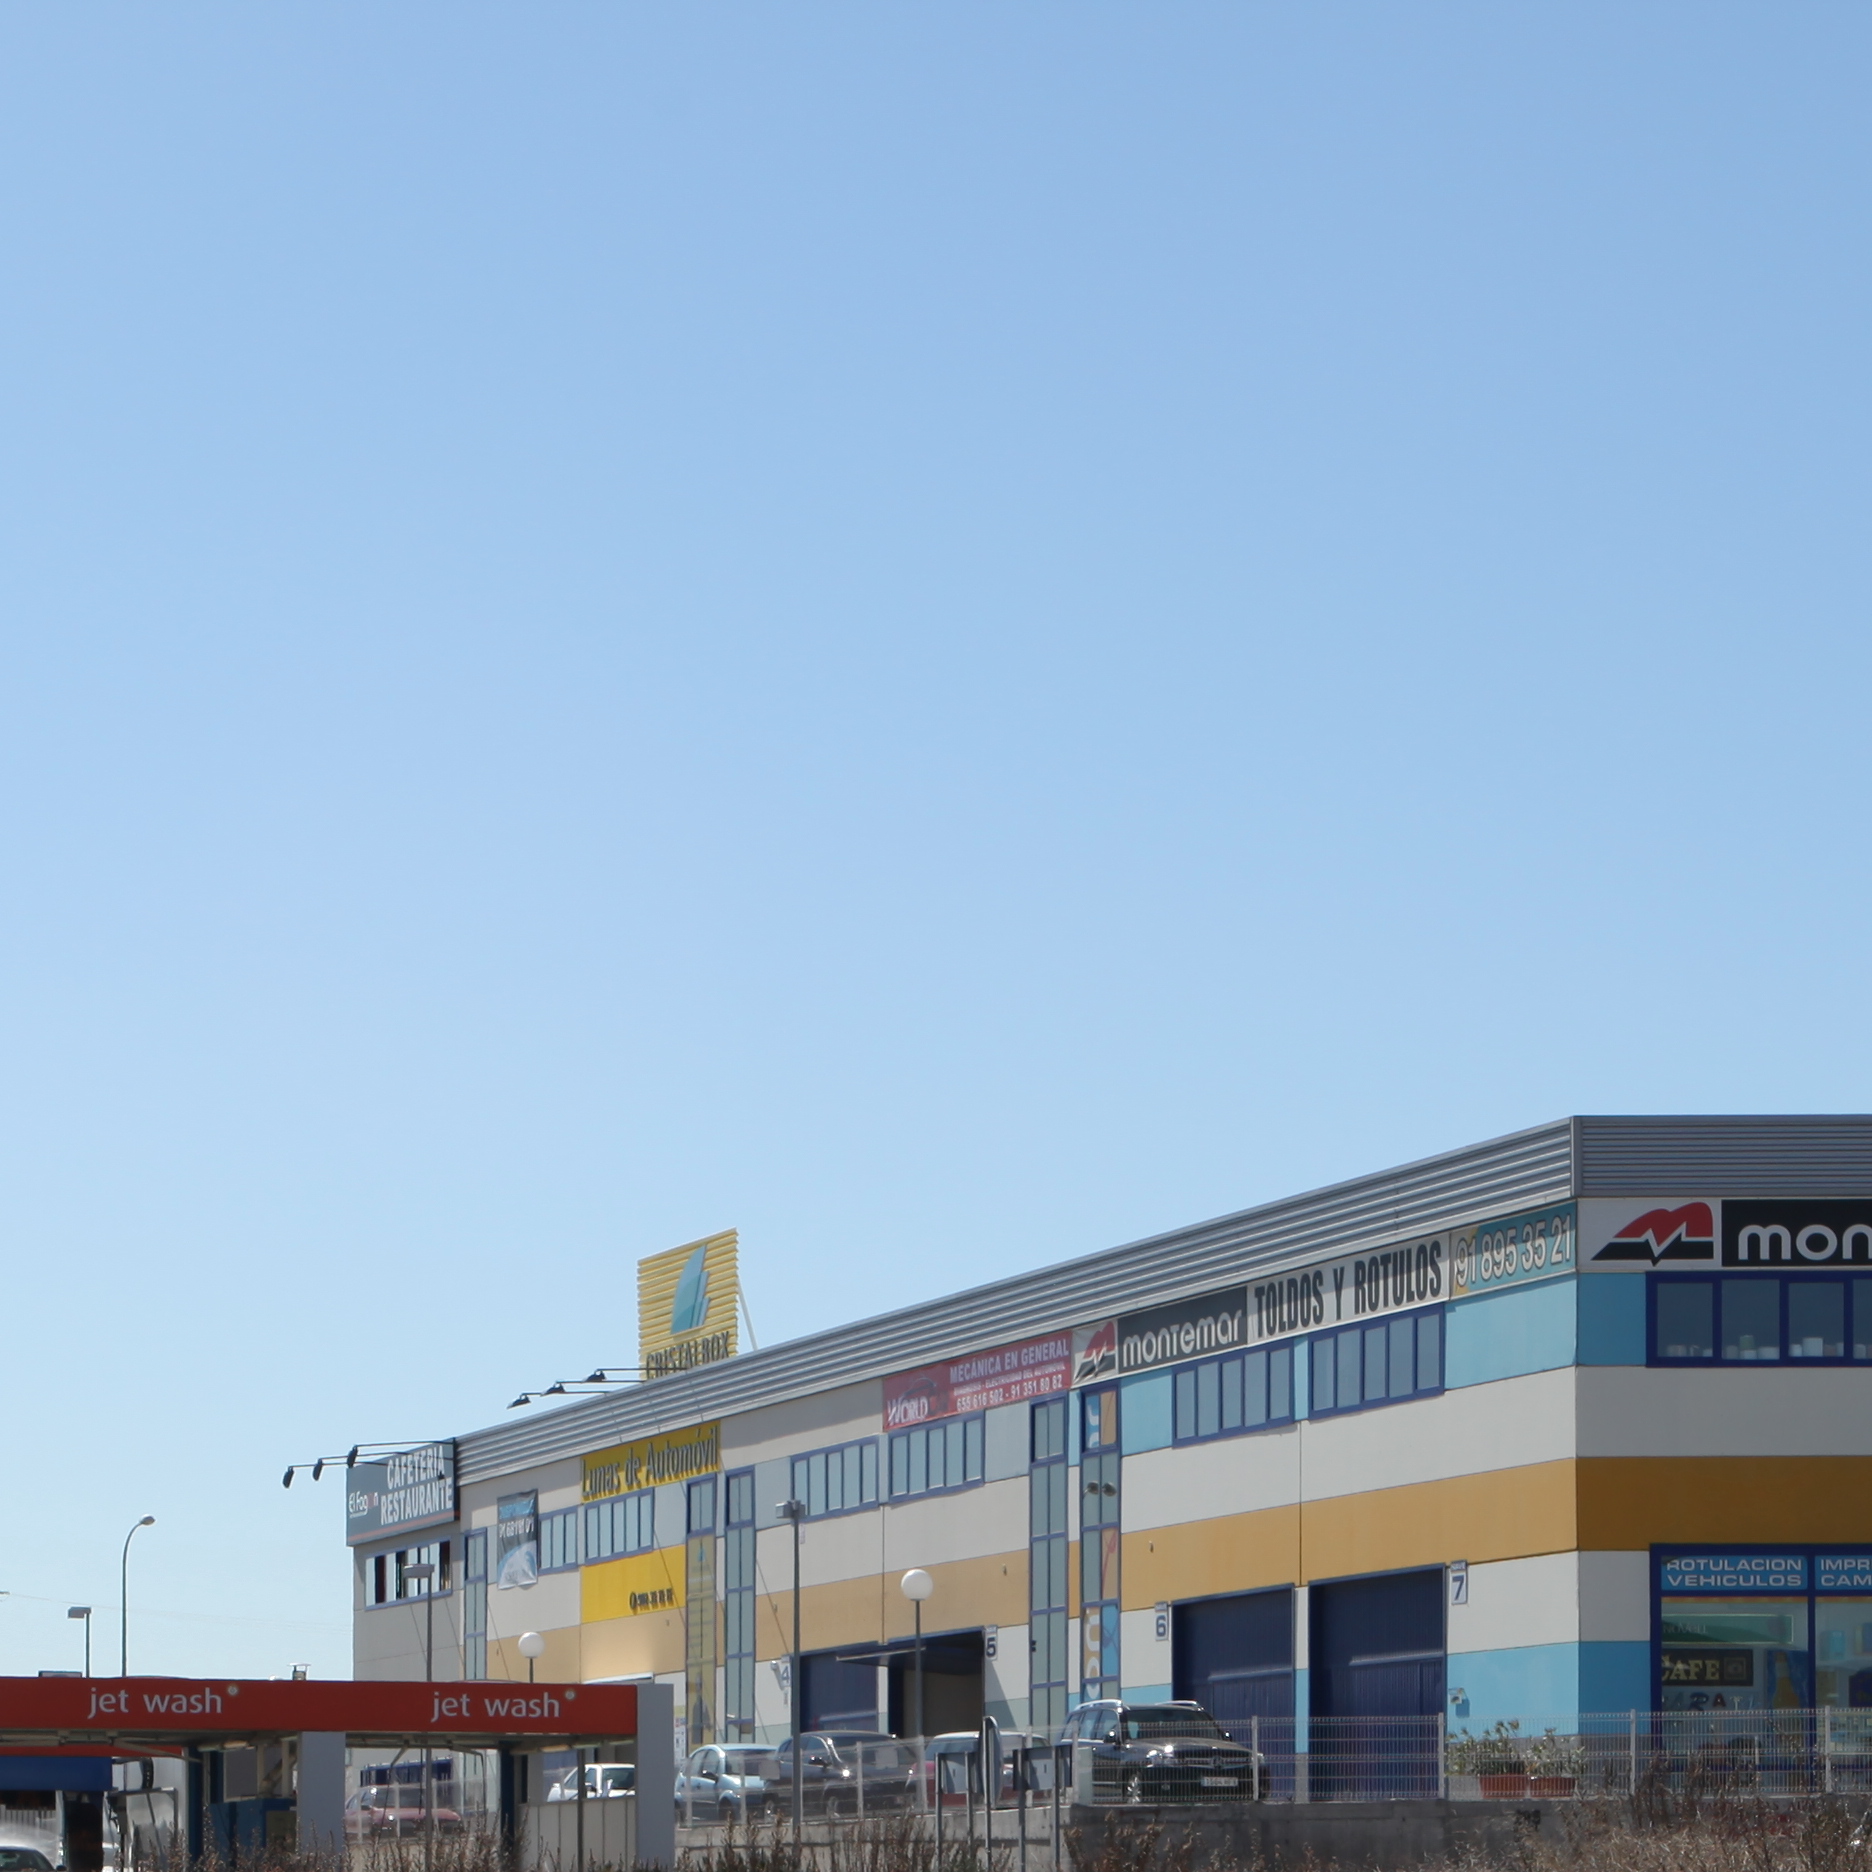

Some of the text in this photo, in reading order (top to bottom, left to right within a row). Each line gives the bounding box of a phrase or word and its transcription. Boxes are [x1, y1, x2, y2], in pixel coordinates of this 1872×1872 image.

[1254, 1270, 1324, 1339] TOLDOS
[1333, 1267, 1346, 1321] Y
[1354, 1240, 1442, 1315] ROTULOS
[1455, 1236, 1477, 1287] 91
[1481, 1227, 1518, 1281] 895
[1521, 1219, 1547, 1272] 35
[1550, 1213, 1572, 1266] 21
[1005, 1351, 1018, 1368] EN
[1021, 1339, 1069, 1366] GENERAL
[582, 1426, 719, 1497] Lunas de Automóvil
[380, 1477, 453, 1525] RESTAURANTE
[1666, 1559, 1802, 1571] ROTULACION
[1452, 1574, 1464, 1601] 7
[1667, 1575, 1802, 1586] VEHICULOS
[1155, 1614, 1167, 1638] 6
[986, 1637, 996, 1657] 5
[781, 1665, 790, 1684] 4
[87, 1687, 223, 1719] jet wash
[430, 1691, 560, 1723] jet wash
